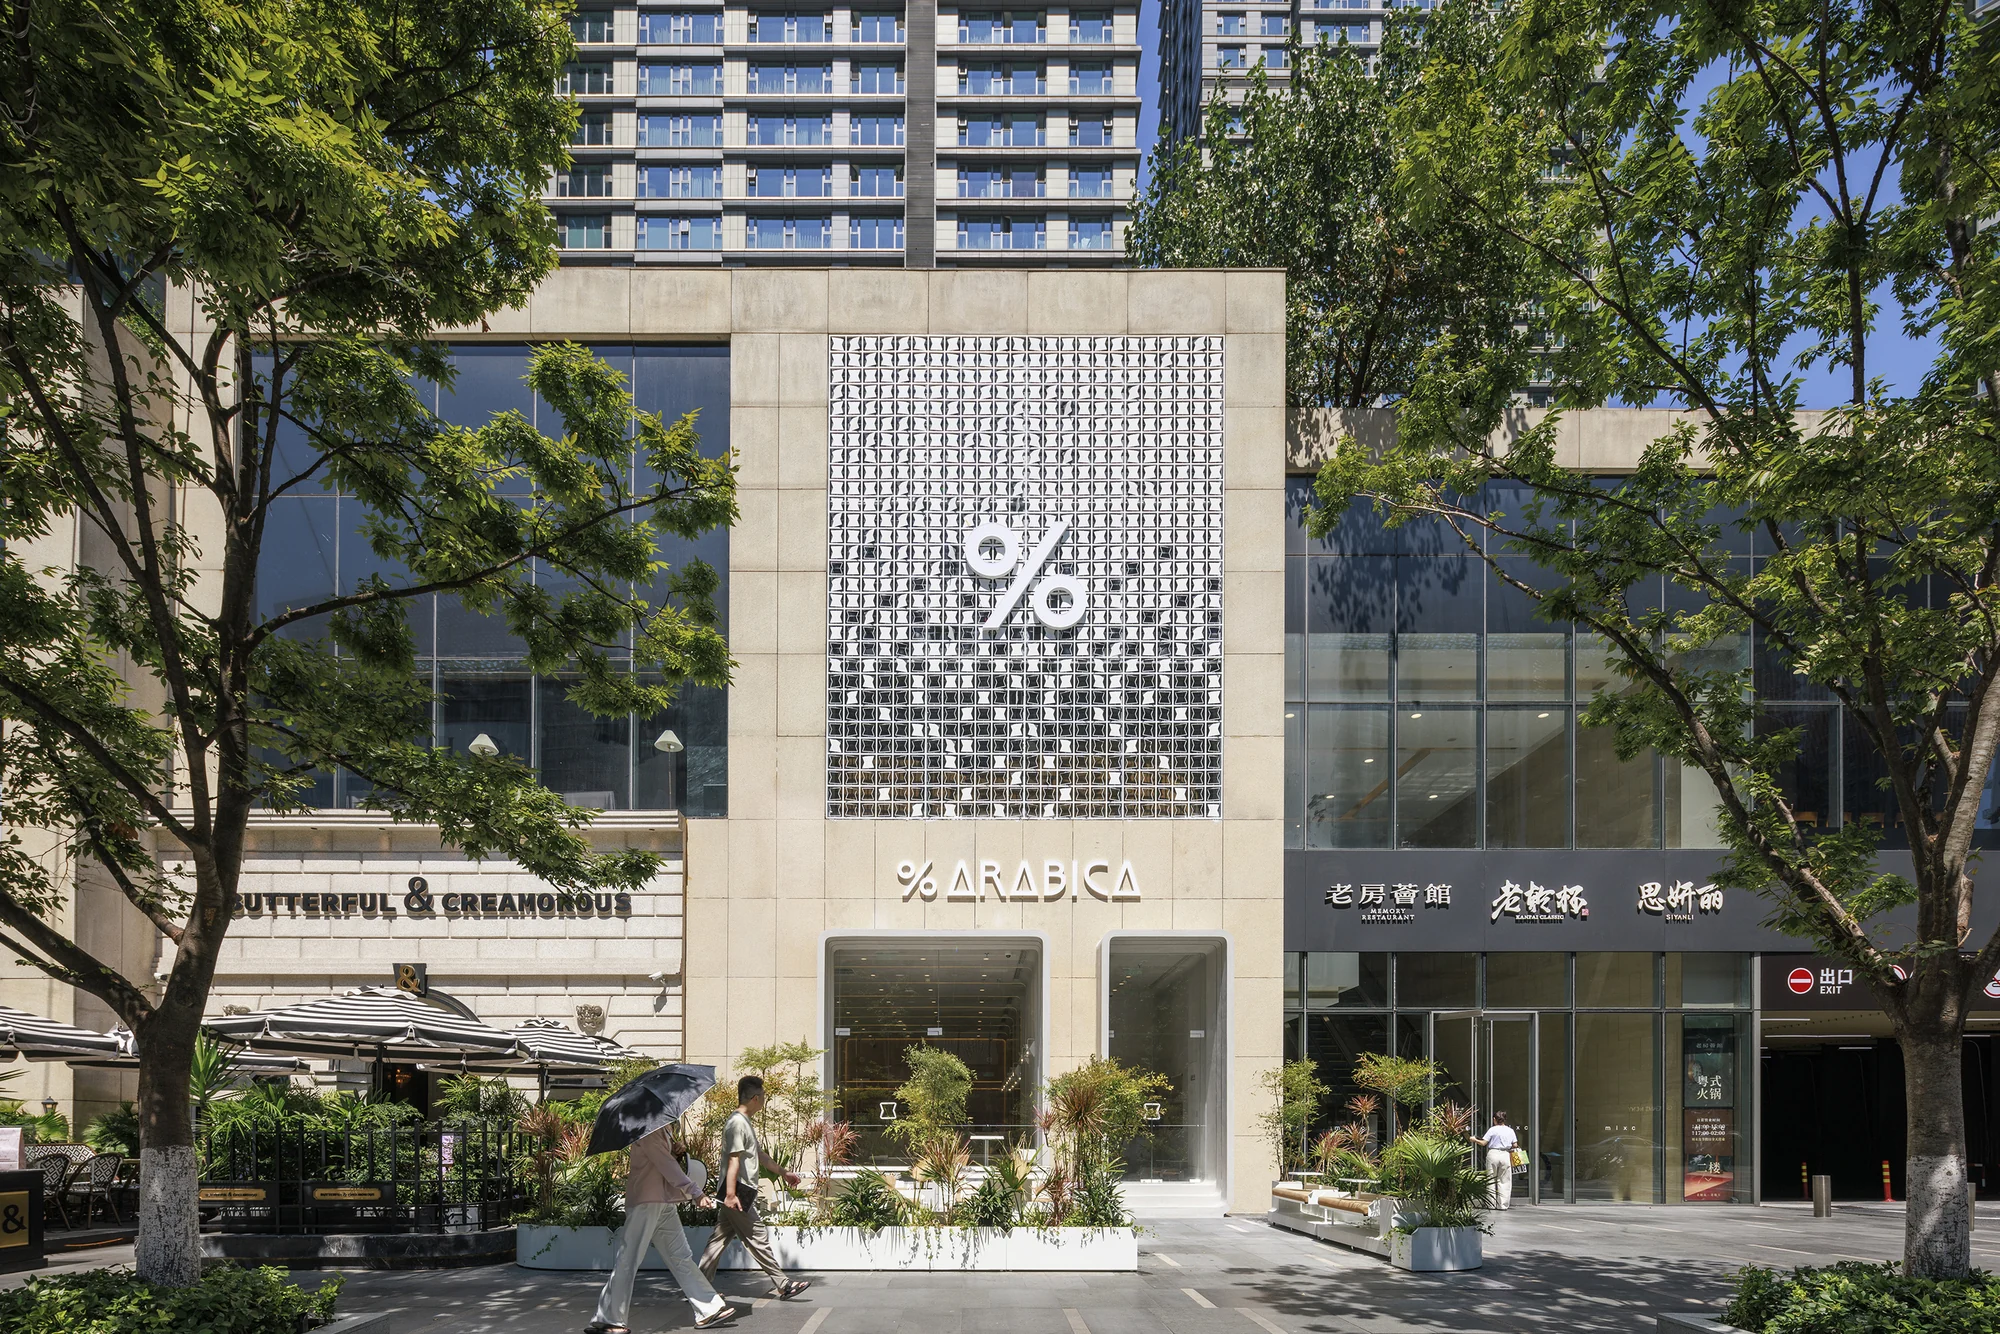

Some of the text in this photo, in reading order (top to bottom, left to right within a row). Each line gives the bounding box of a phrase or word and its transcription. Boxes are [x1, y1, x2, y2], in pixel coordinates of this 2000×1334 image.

[947, 859, 1141, 899] ARABICA
[404, 876, 435, 912] &
[1325, 883, 1453, 904] 老房薈館
[397, 965, 422, 992] &
[1820, 967, 1853, 985] 出口
[1820, 985, 1843, 995] EXIT
[1697, 1088, 1722, 1100] 火锅
[2, 1204, 28, 1234] &
